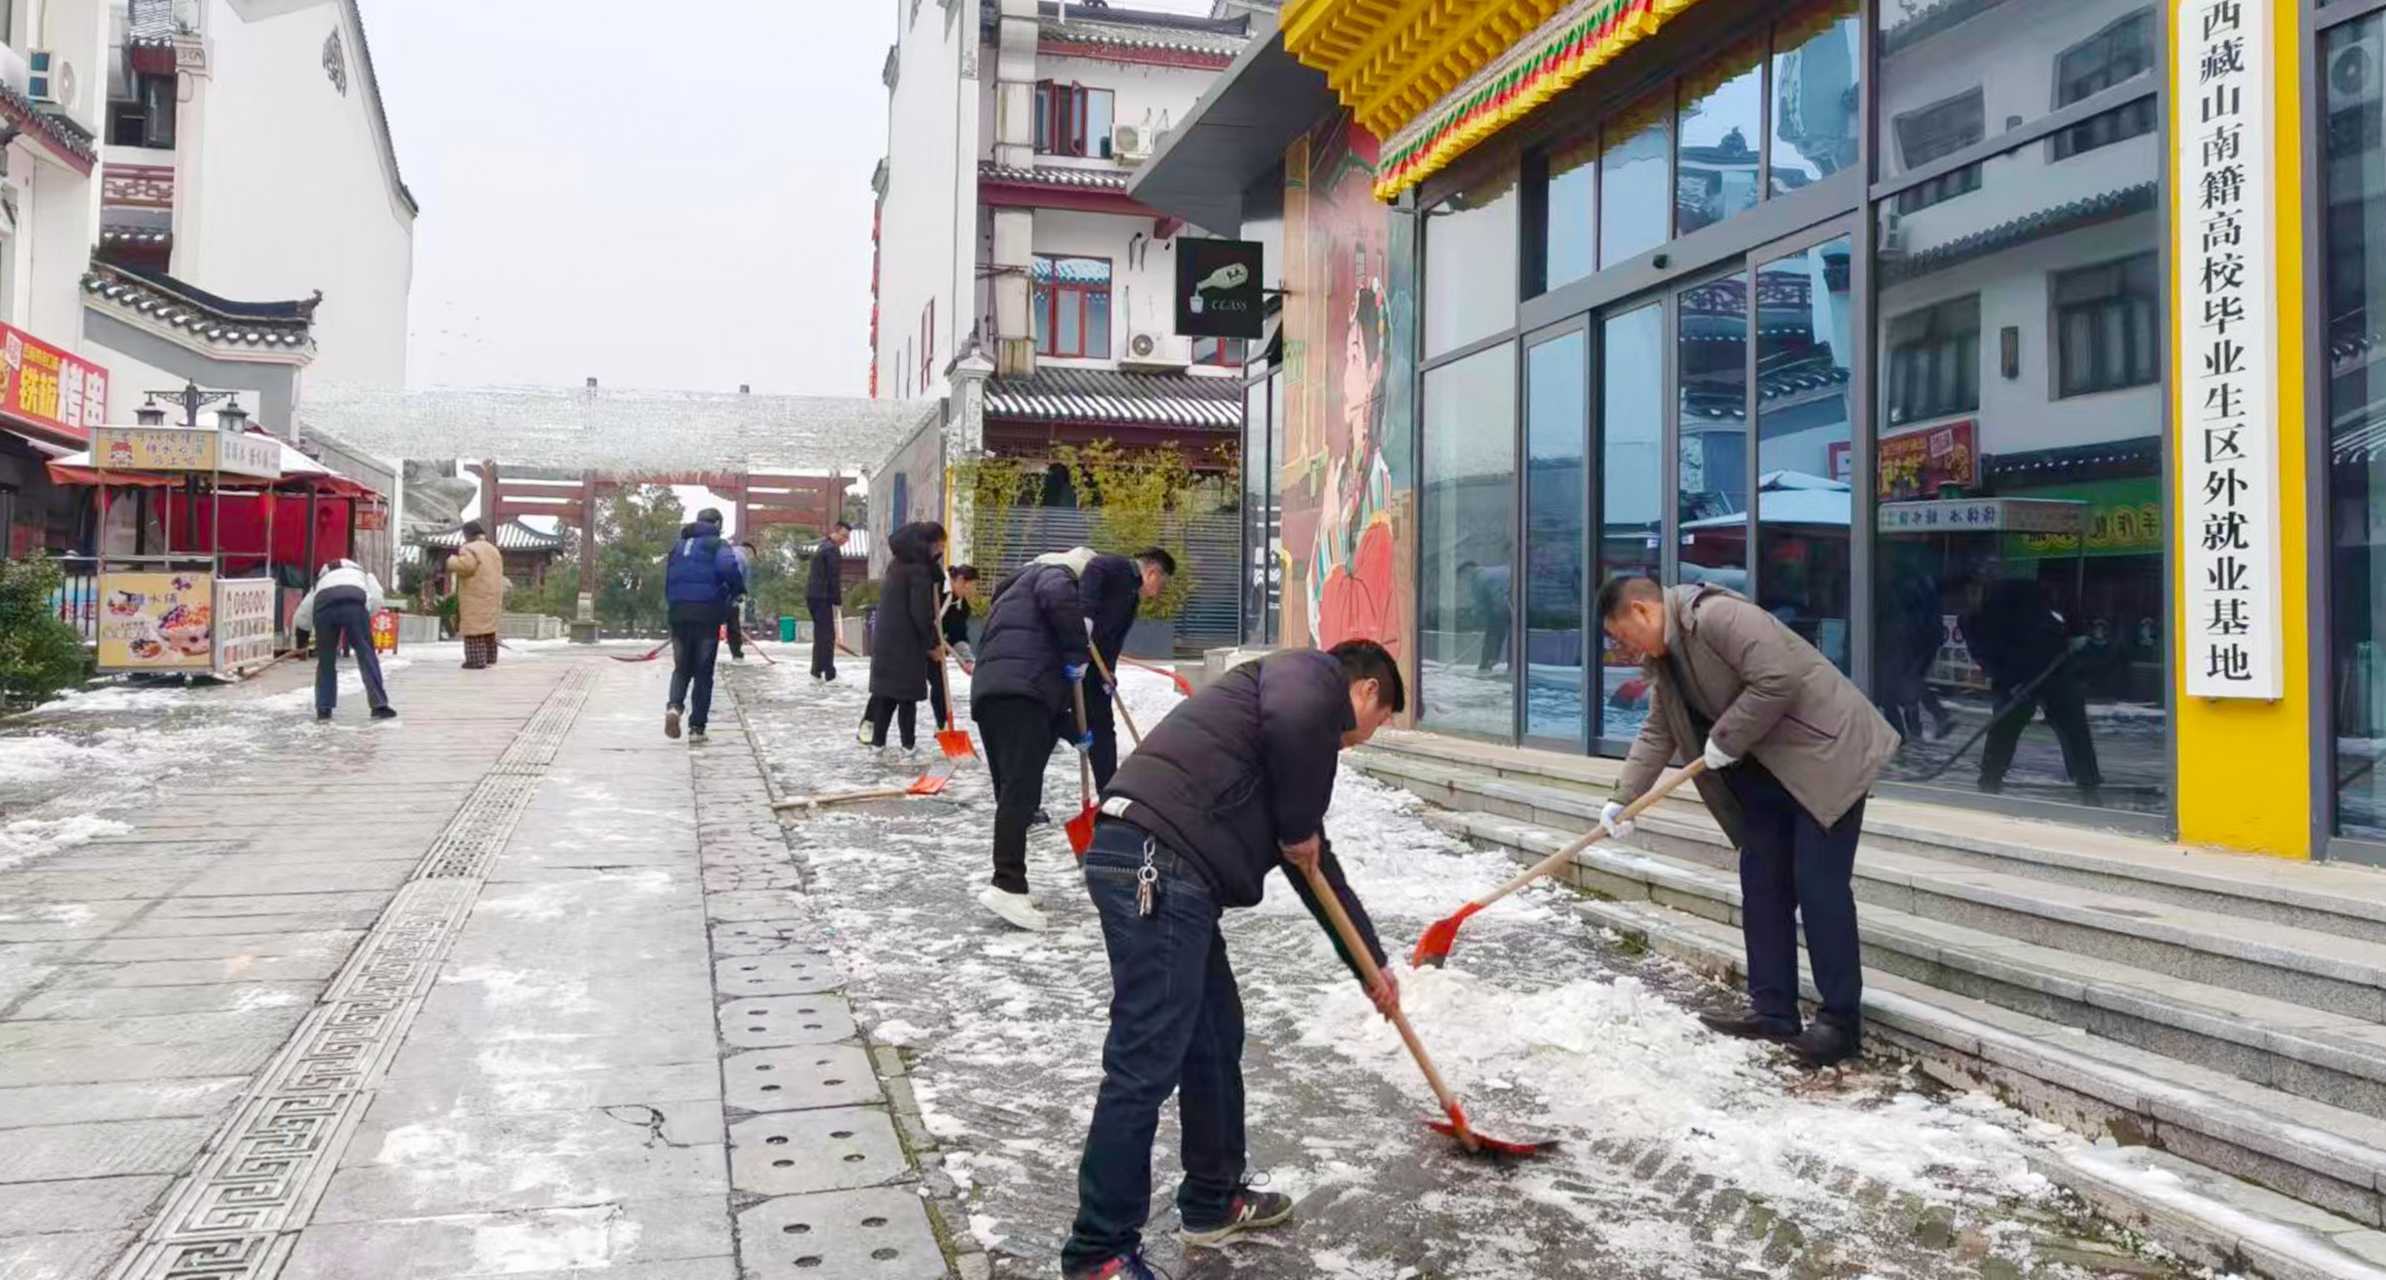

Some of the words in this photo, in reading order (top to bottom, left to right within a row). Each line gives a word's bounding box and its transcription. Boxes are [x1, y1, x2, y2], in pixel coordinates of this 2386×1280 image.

[2198, 0, 2253, 682] 西藏山南籍高校毕业生区外就业基地
